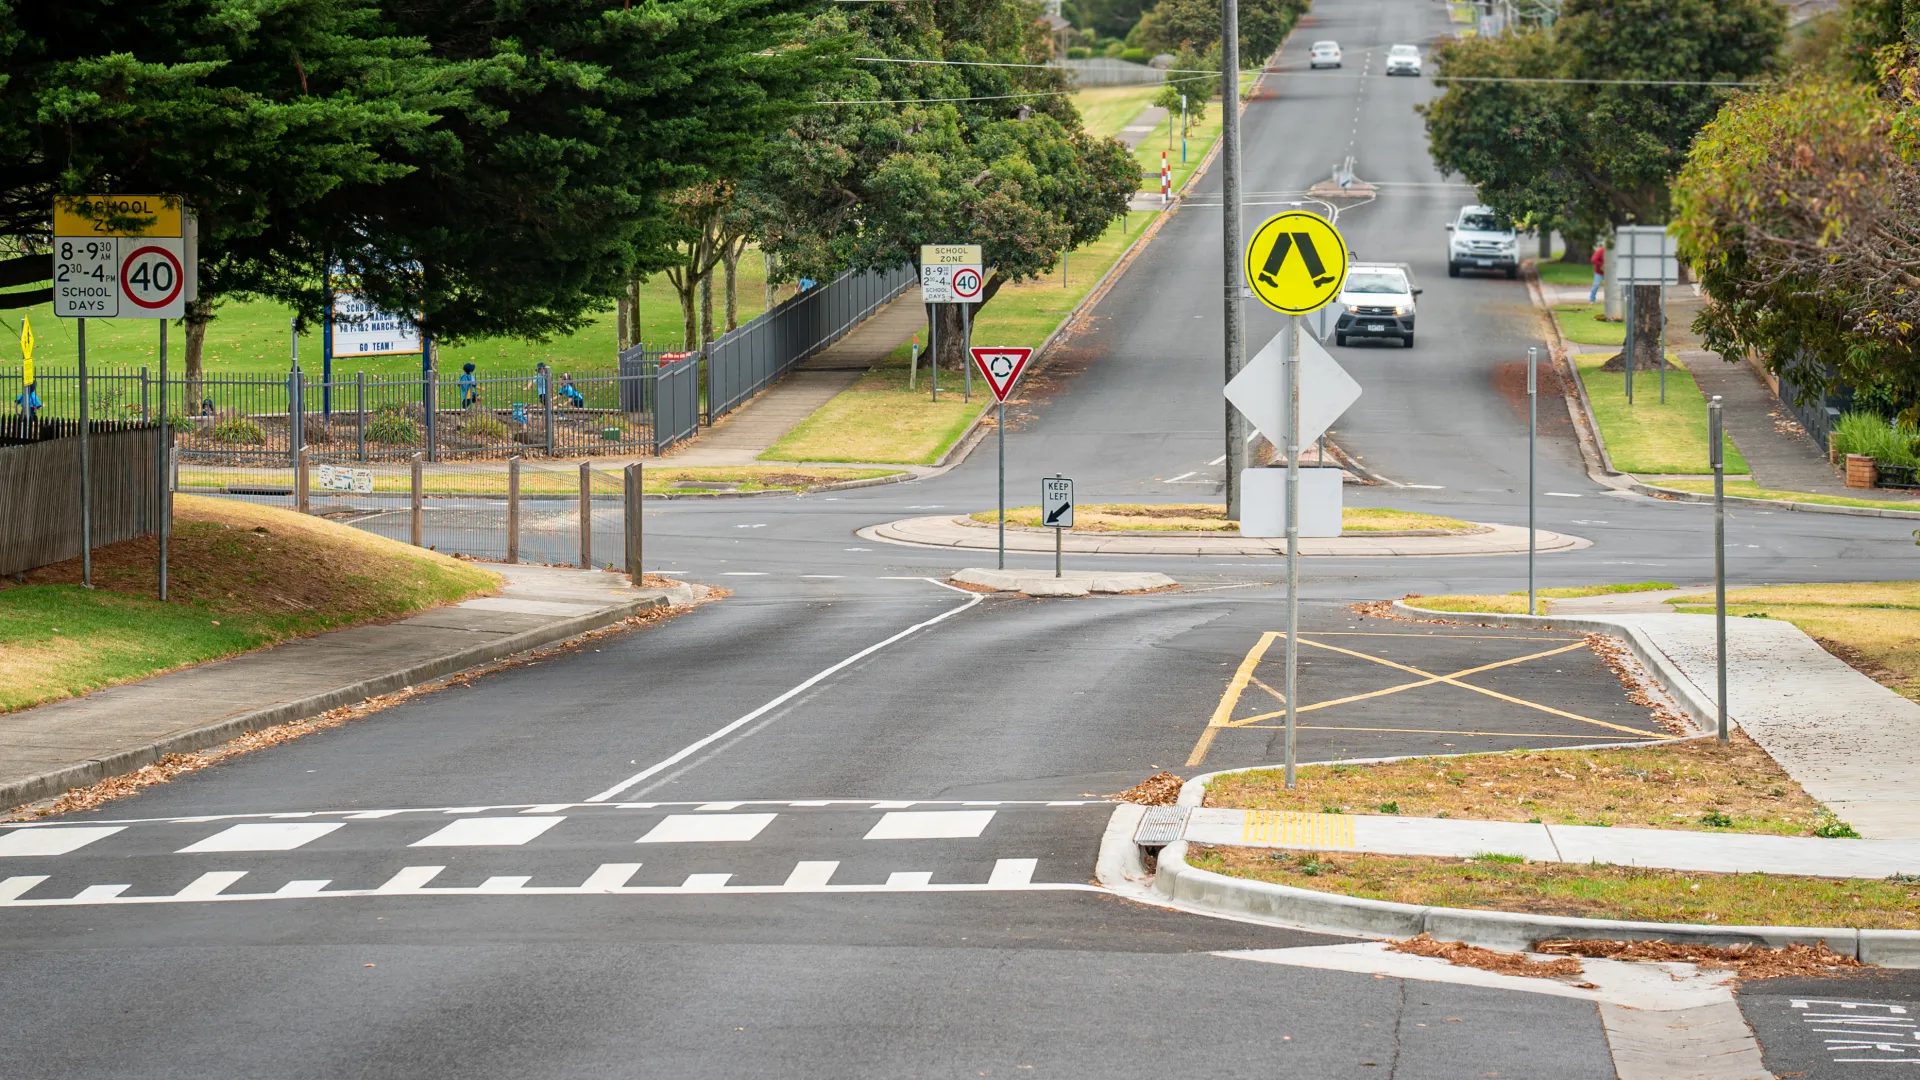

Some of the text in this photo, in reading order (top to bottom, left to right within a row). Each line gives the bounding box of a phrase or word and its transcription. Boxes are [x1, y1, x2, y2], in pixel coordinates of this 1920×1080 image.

[94, 219, 141, 232] ZO
[129, 262, 173, 291] 40
[957, 276, 977, 289] 40
[62, 287, 111, 297] SCHOOL
[69, 301, 104, 311] DAYS
[371, 322, 394, 331] MARCH
[360, 343, 368, 351] GO
